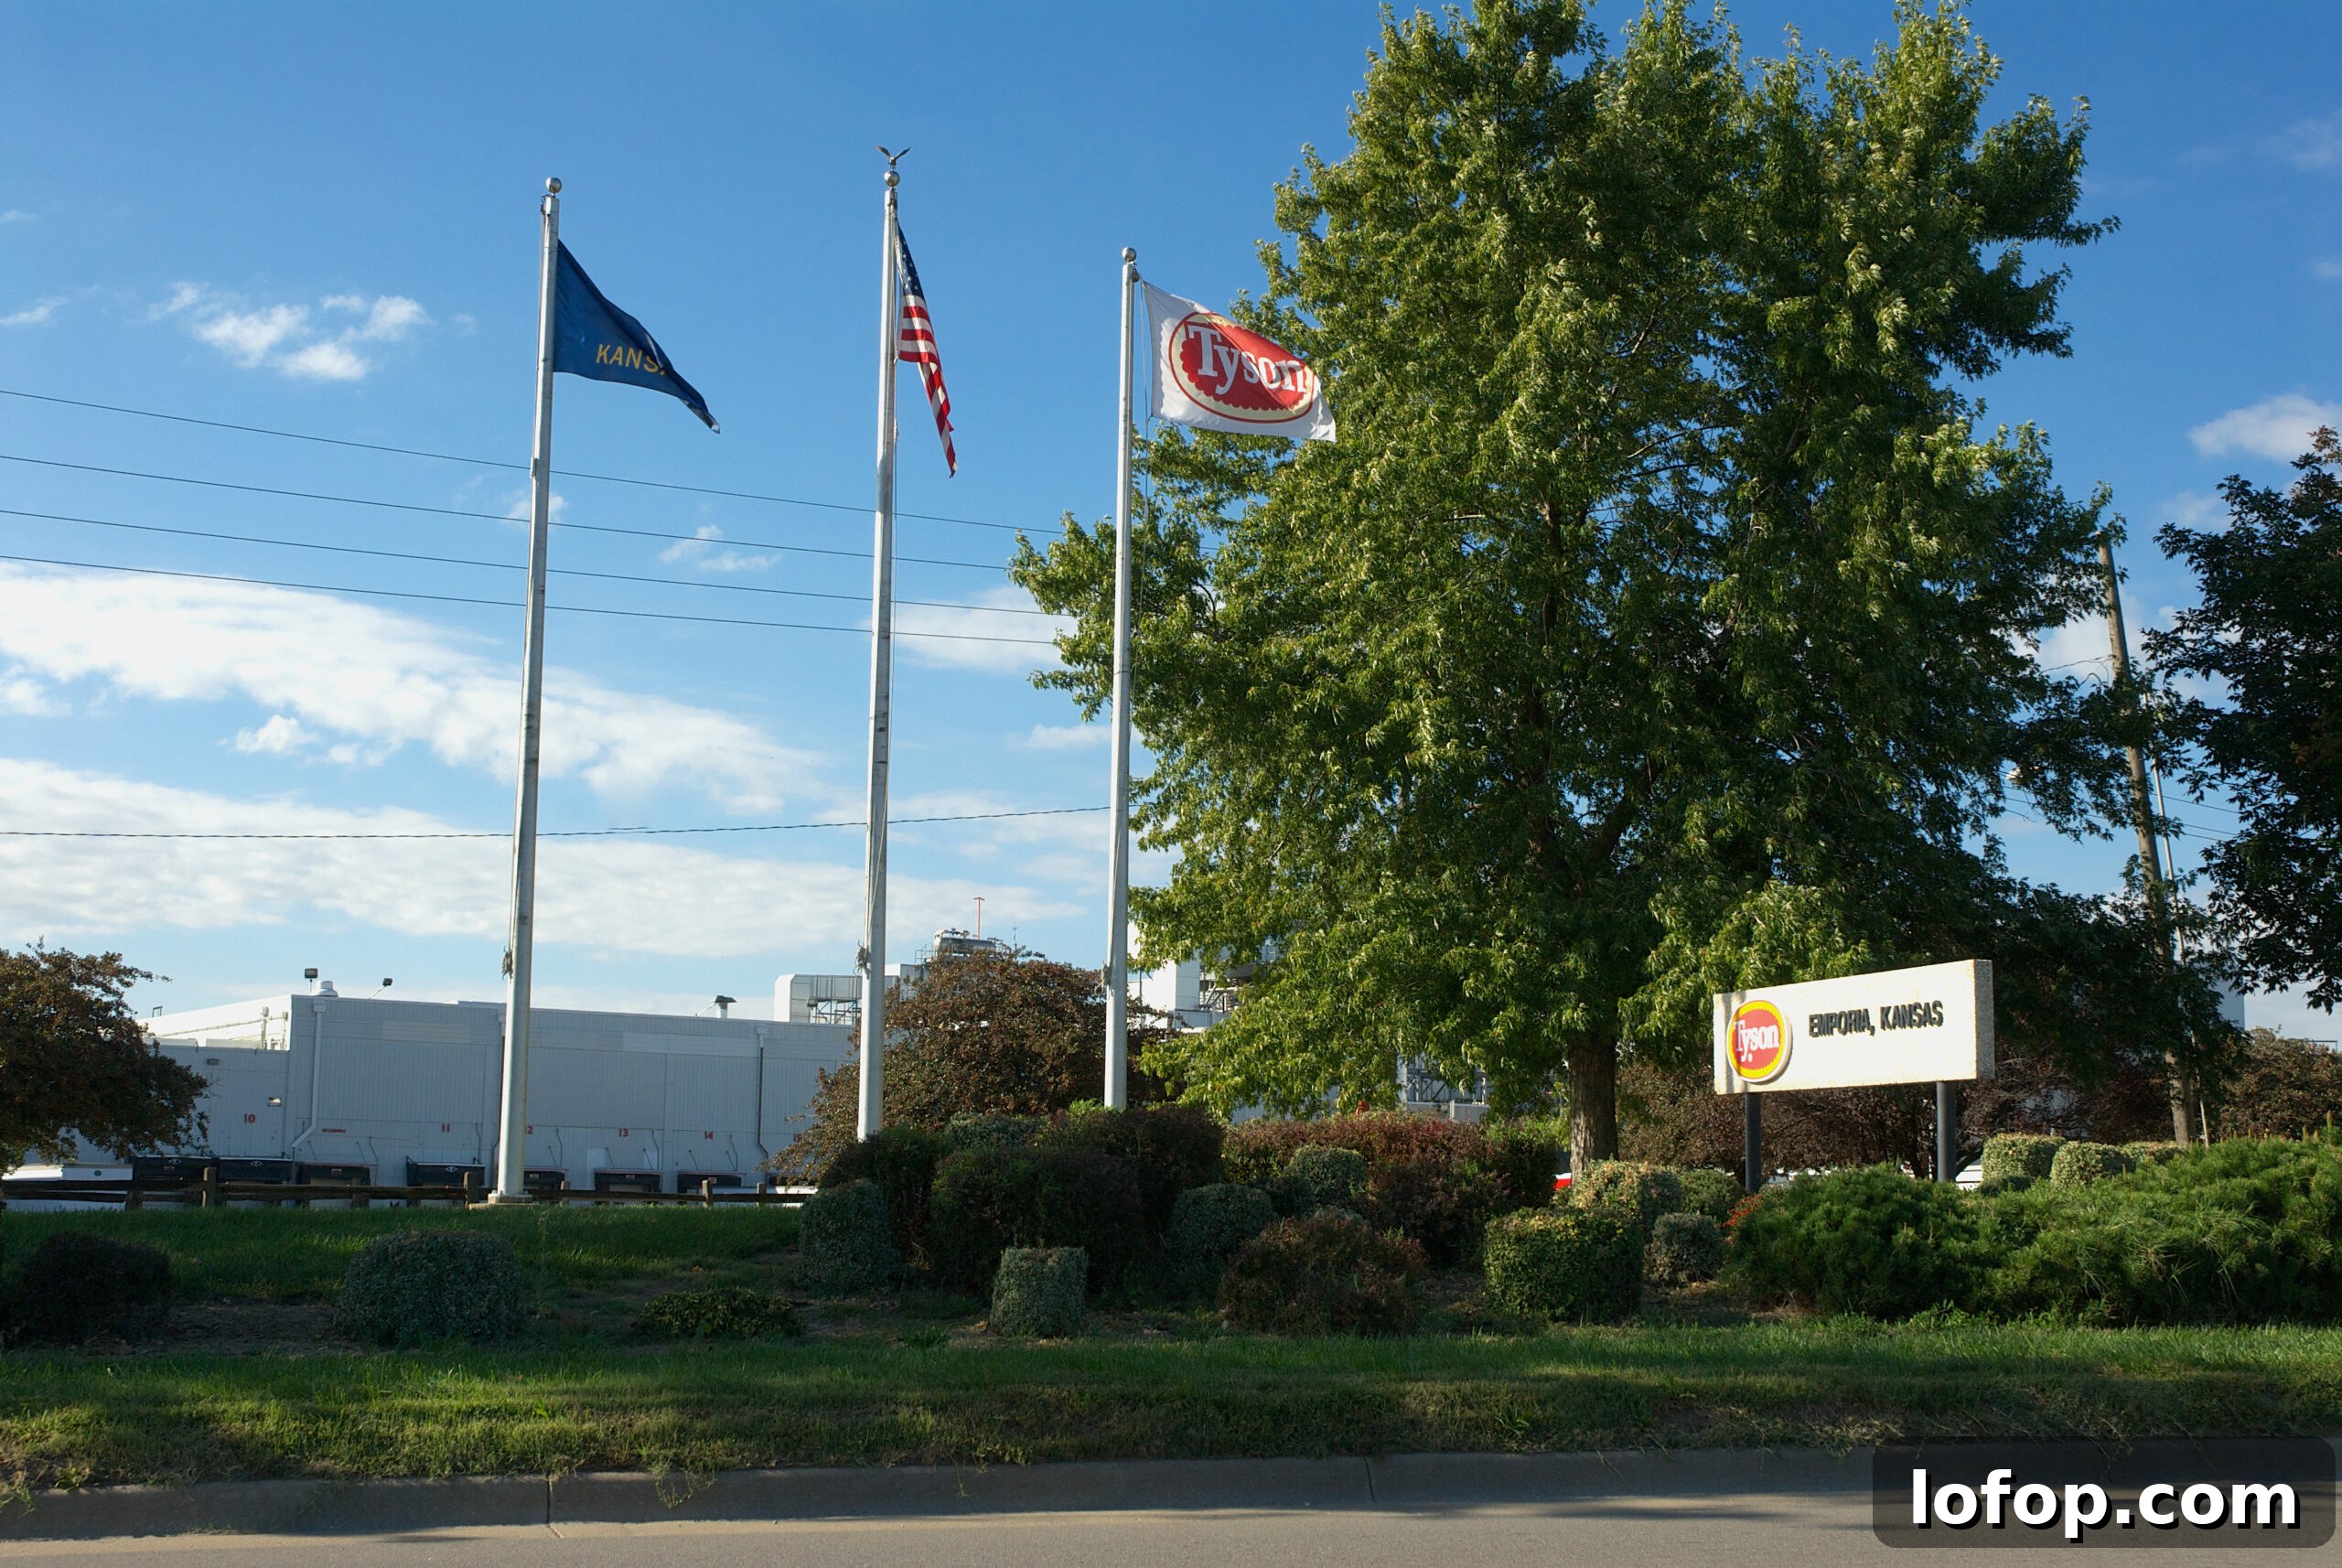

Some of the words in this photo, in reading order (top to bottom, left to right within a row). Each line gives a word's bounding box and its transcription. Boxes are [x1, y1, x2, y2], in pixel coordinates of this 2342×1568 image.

[1188, 325, 1308, 395] Tyson
[1809, 1008, 1875, 1037] EMPORIA,
[1881, 1001, 1943, 1030] KANSAS
[1734, 1019, 1780, 1062] Tyson
[242, 1113, 256, 1123] 10
[618, 1128, 628, 1137] 13
